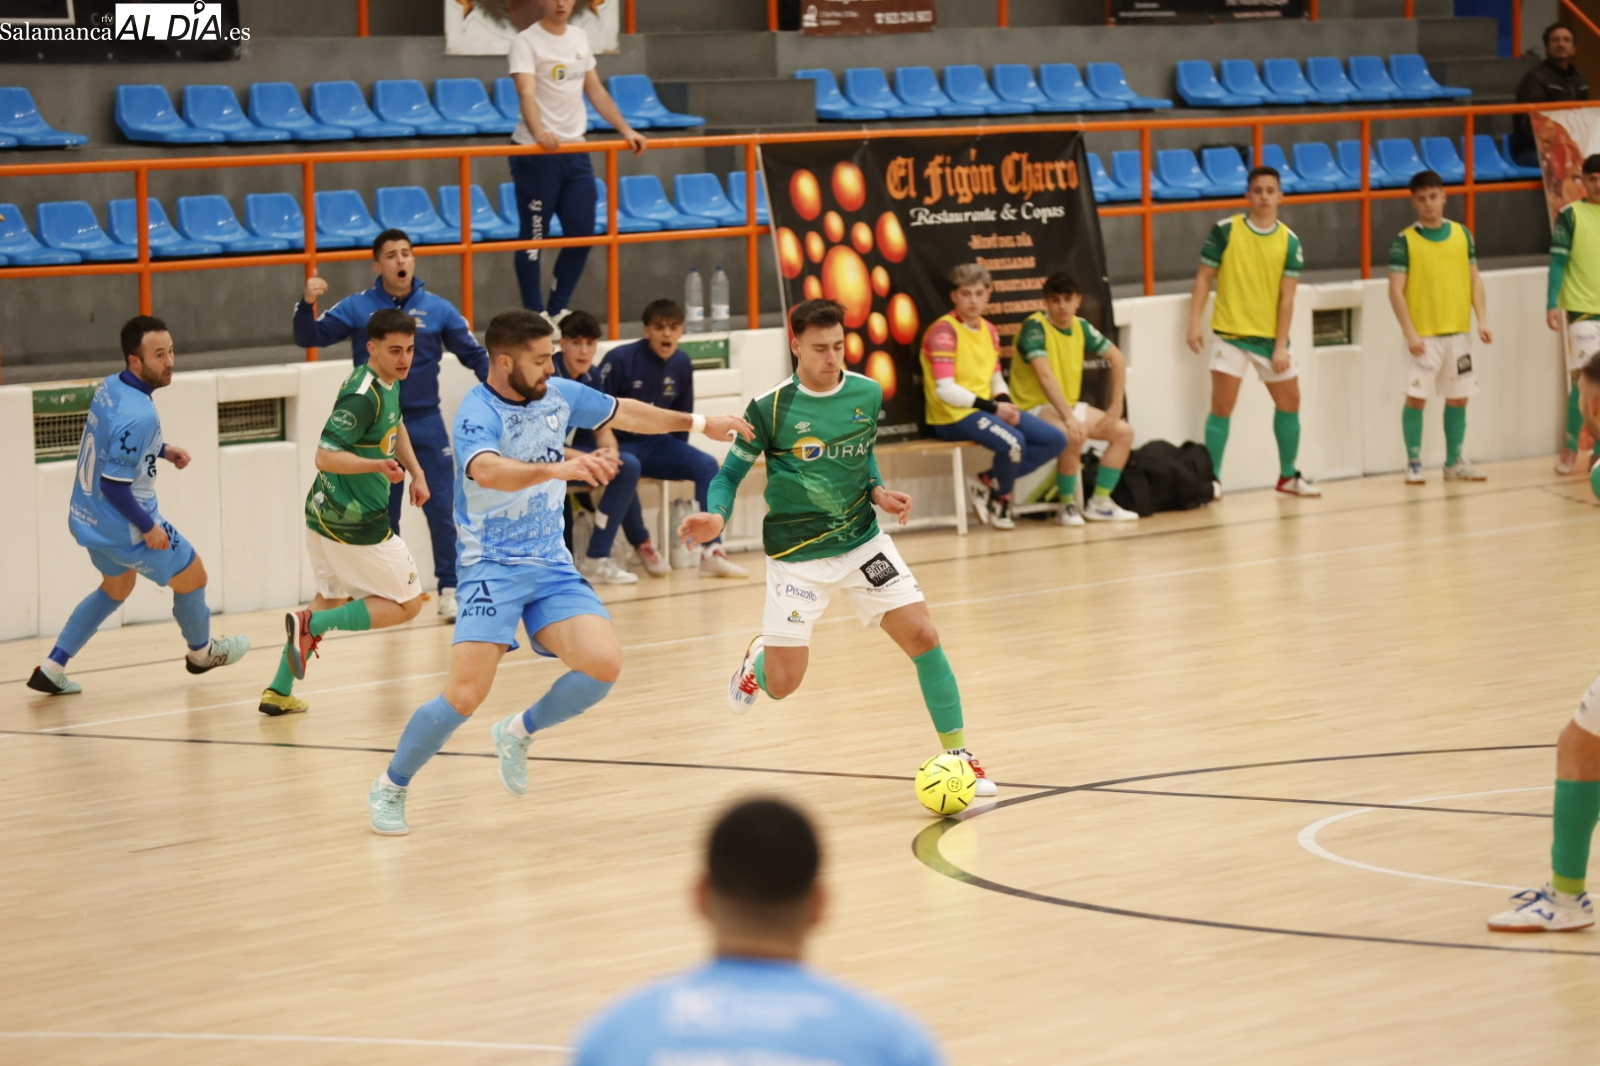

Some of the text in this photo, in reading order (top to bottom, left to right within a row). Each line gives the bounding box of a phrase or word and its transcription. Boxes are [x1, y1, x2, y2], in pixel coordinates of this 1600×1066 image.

[886, 156, 917, 200] El
[1001, 152, 1080, 201] Charro
[909, 202, 1066, 227] Restaurante & Copas
[461, 605, 497, 619] ACTIO
